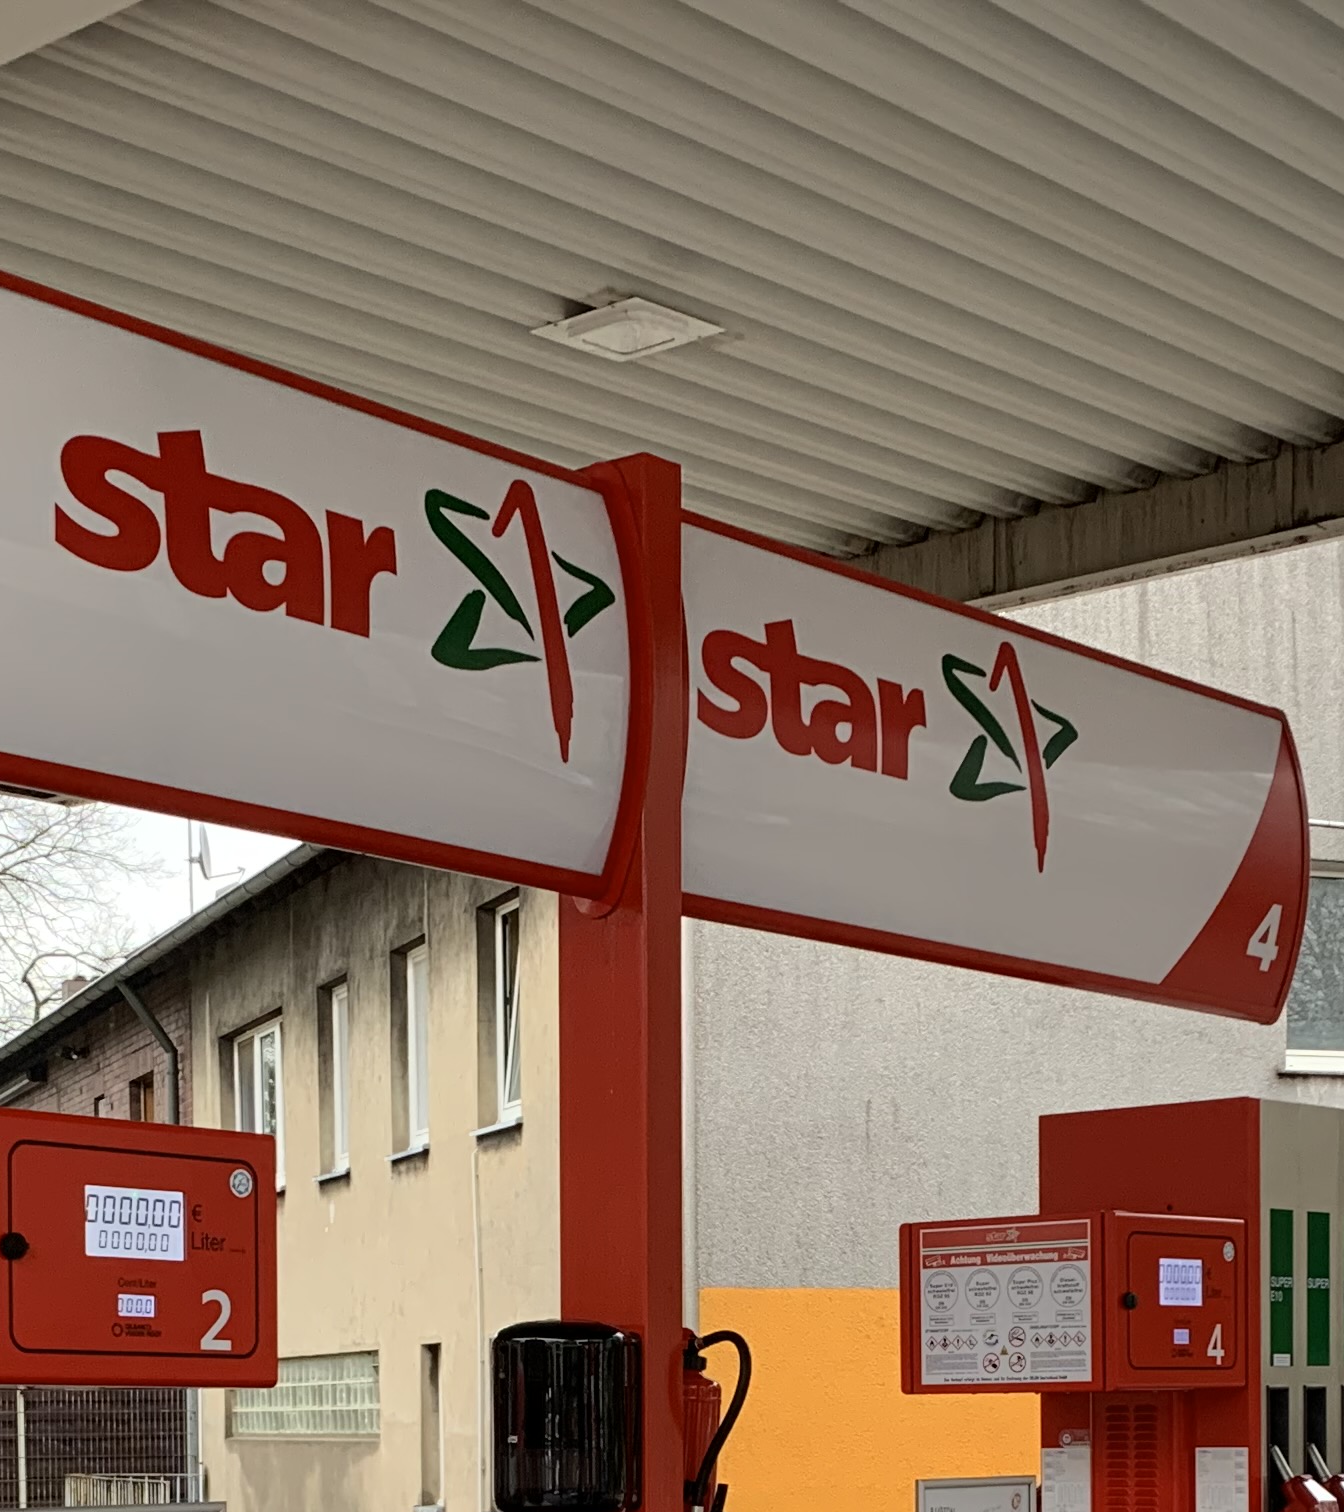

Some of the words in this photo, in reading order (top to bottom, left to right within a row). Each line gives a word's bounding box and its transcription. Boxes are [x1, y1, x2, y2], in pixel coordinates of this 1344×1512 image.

[54, 430, 398, 639] star
[697, 618, 927, 781] star
[1246, 903, 1283, 973] 4
[192, 1204, 203, 1223] €
[99, 1230, 169, 1253] 0000,00
[191, 1232, 227, 1251] Liter
[950, 1254, 981, 1265] Achtung
[1270, 1276, 1293, 1289] SUPER
[1308, 1277, 1329, 1289] SUPER
[1270, 1291, 1283, 1302] E10
[200, 1289, 233, 1351] 2
[1207, 1324, 1225, 1365] 4
